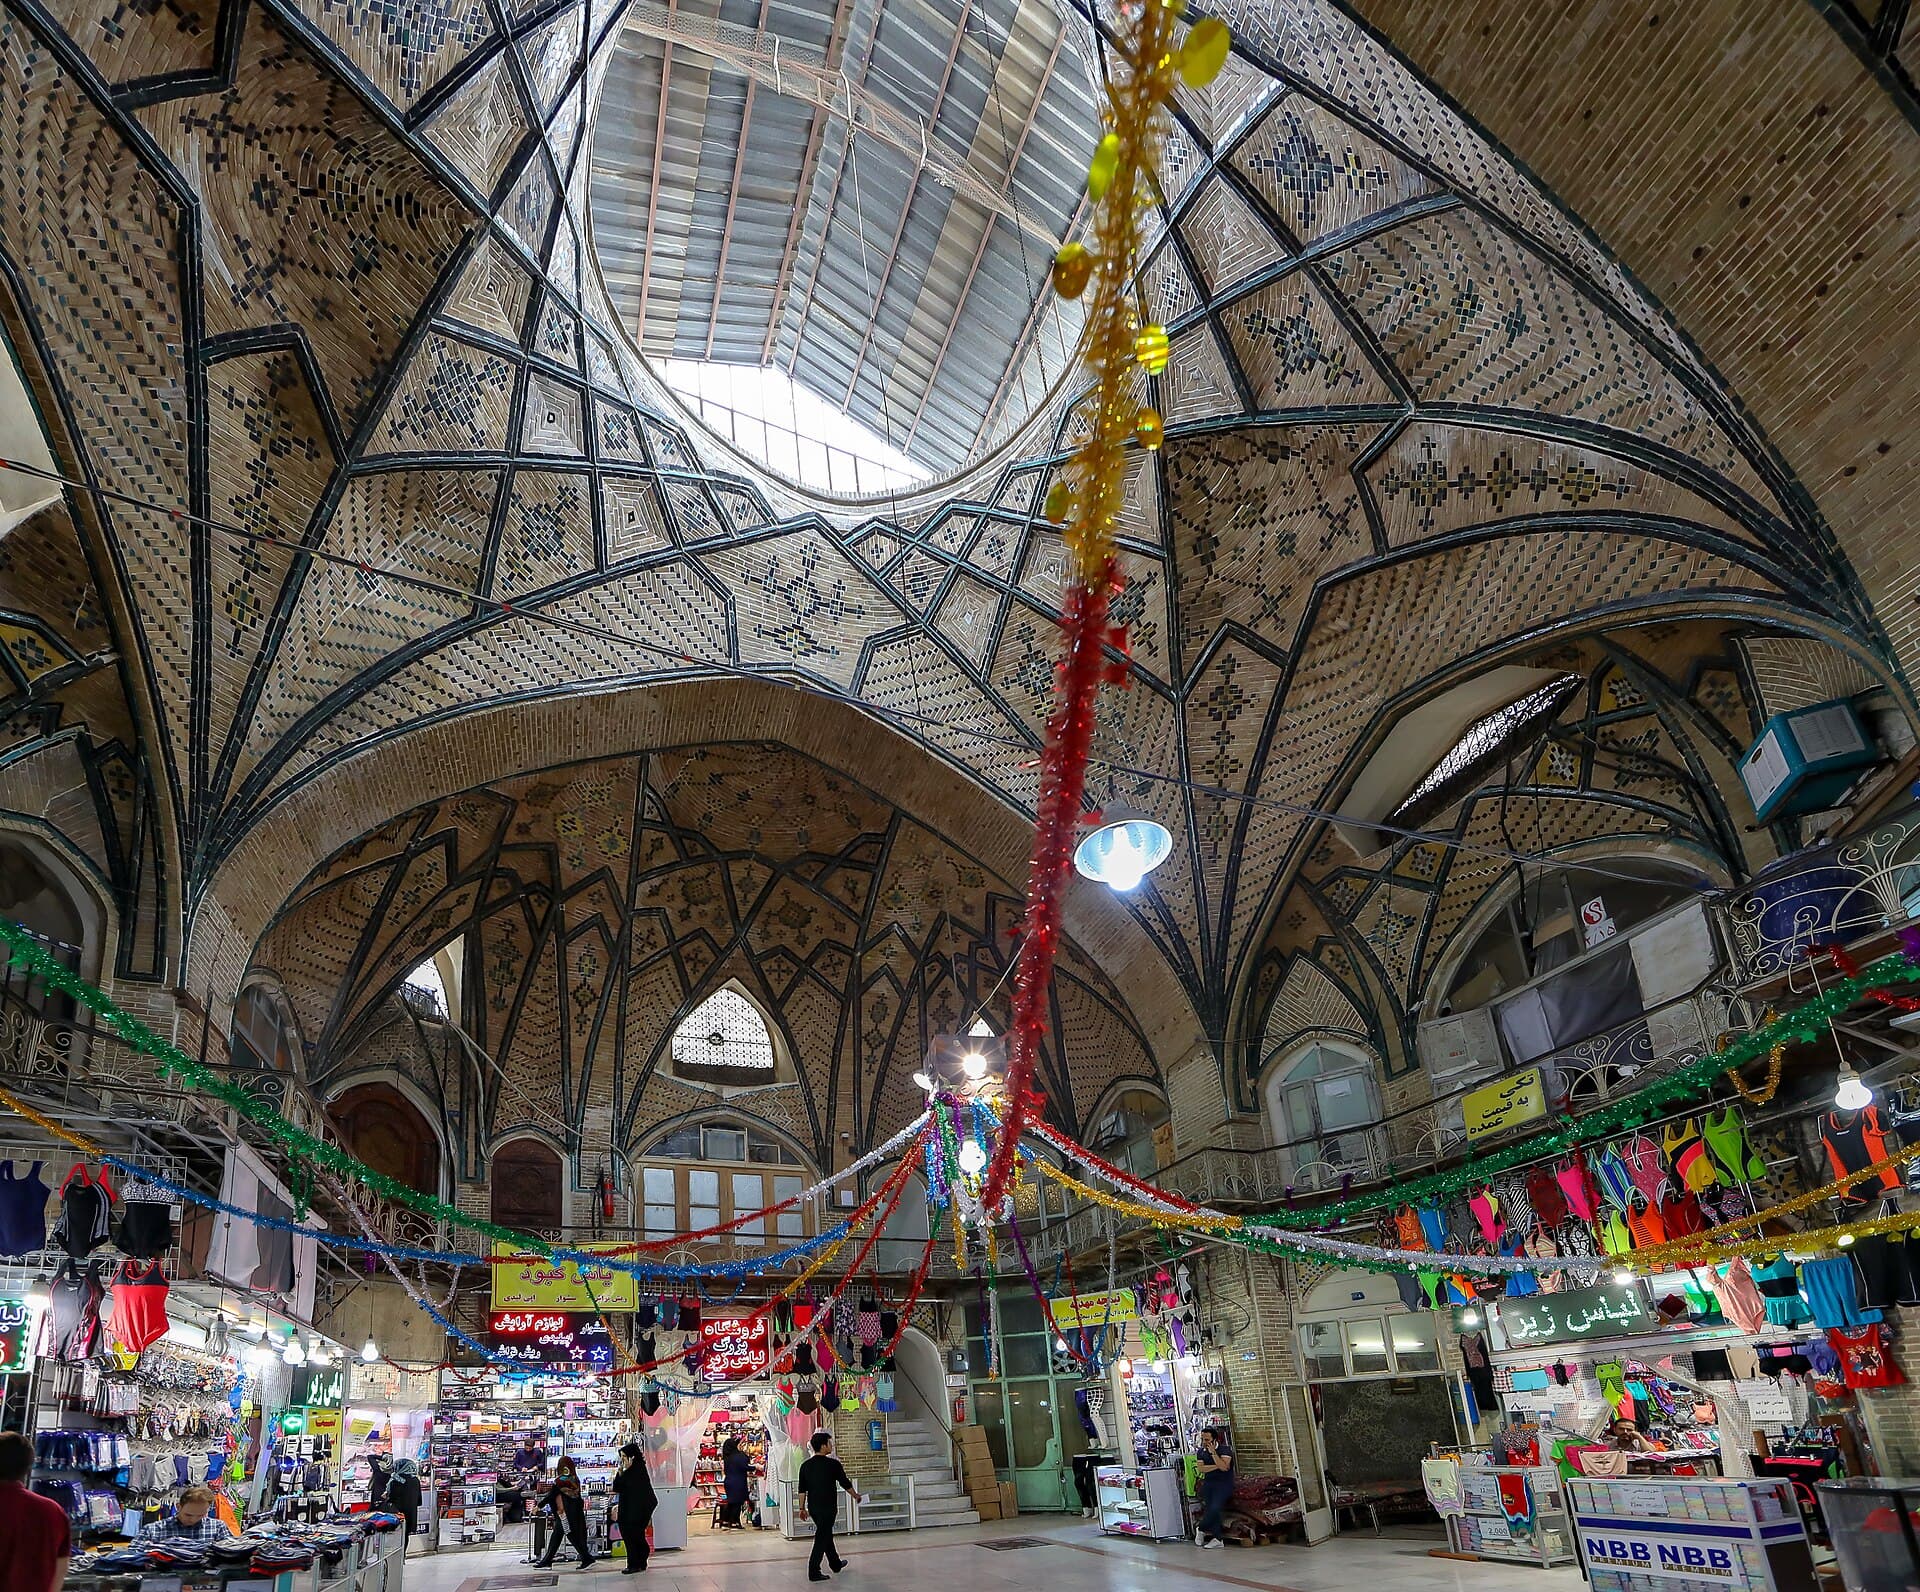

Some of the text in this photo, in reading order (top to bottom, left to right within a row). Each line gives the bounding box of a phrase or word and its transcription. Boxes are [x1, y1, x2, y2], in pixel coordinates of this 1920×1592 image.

[1500, 1073, 1534, 1099] تکی
[1482, 1096, 1529, 1119] به قیمت
[1469, 1117, 1504, 1135] عمده
[519, 1266, 566, 1286] کبود
[494, 1313, 564, 1332] لوازم آرایش
[1512, 1288, 1642, 1339] لباس زیر
[704, 1319, 765, 1340] فروشگاه
[518, 1345, 541, 1360] ریش
[712, 1336, 749, 1356] بزرگ
[706, 1350, 765, 1372] لباس زیر
[1586, 1538, 1733, 1569] NBB NBB
[1590, 1555, 1733, 1577] PREMIUM PREMIUM
